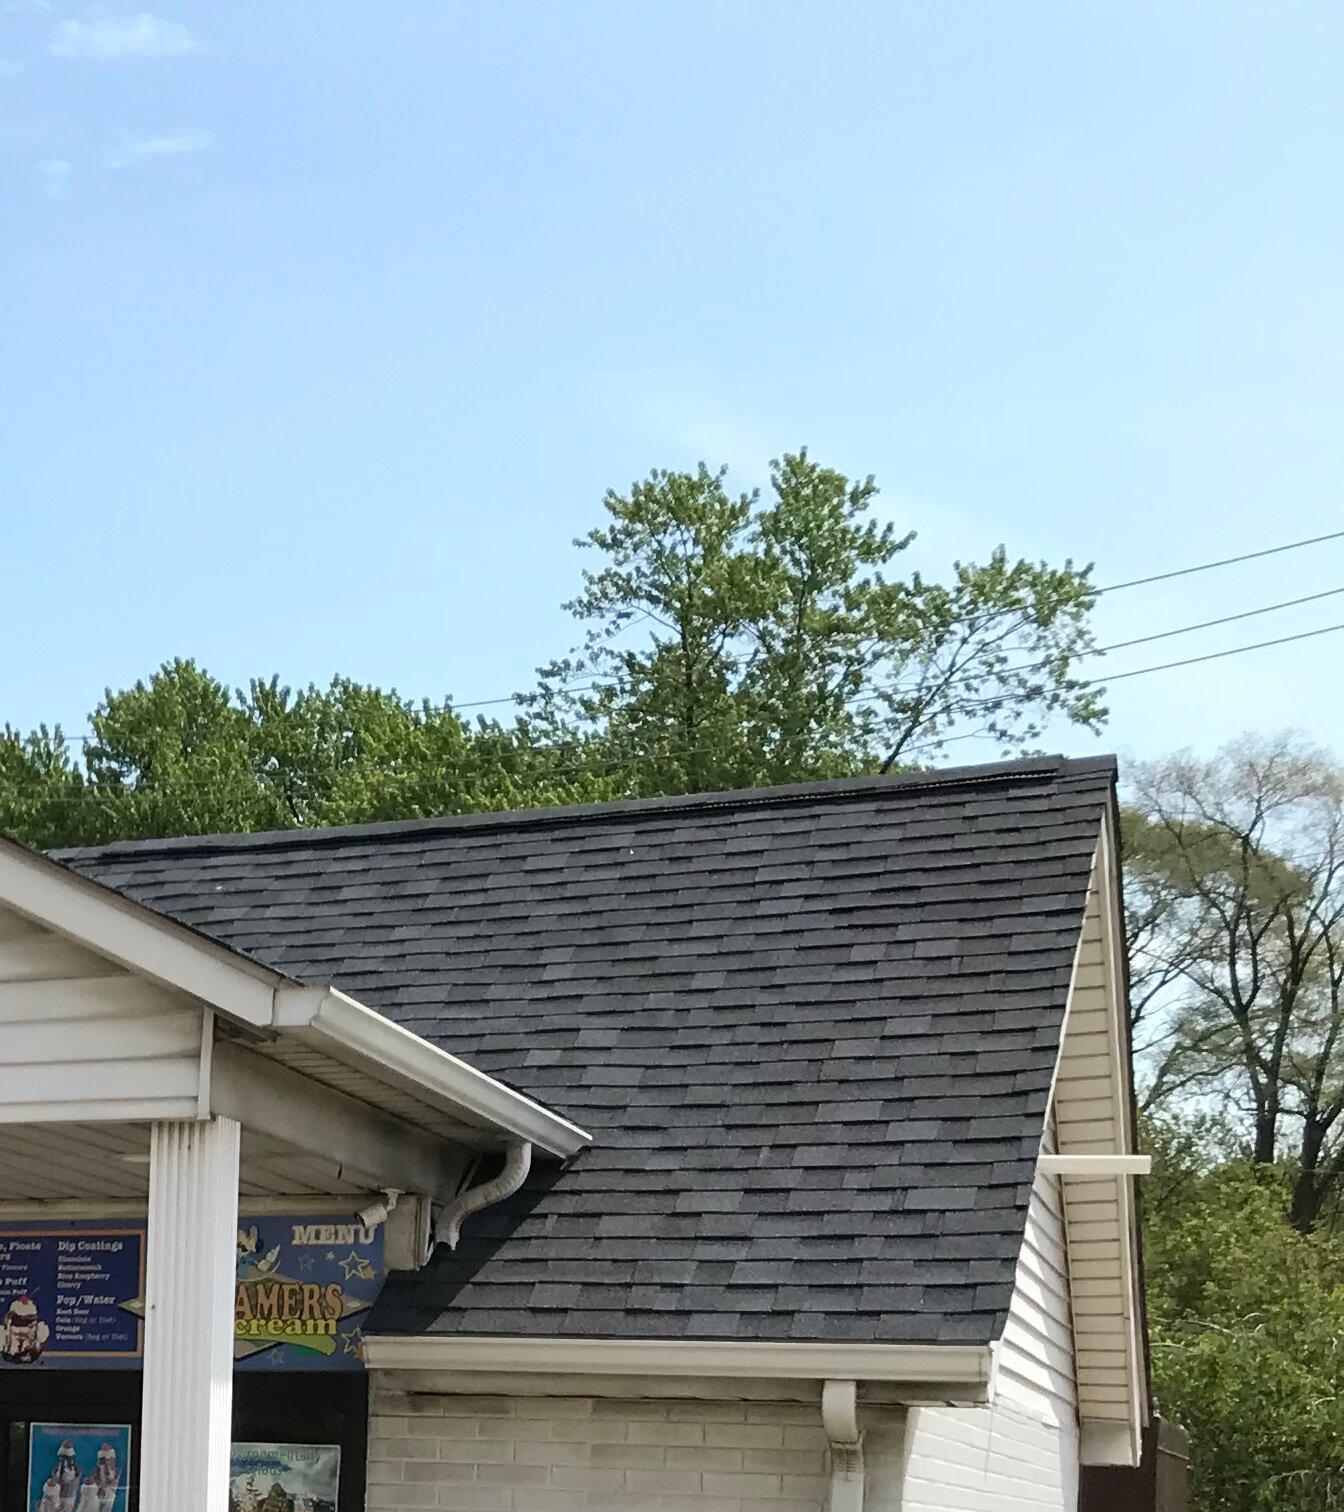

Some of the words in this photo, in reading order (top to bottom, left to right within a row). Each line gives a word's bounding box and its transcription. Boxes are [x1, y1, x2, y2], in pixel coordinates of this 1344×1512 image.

[292, 1224, 378, 1246] MENU
[9, 1242, 41, 1251] Floats
[58, 1241, 76, 1252] Dip
[78, 1241, 123, 1252] Coatings
[56, 1295, 116, 1307] Pop/Water
[236, 1283, 344, 1321] AMERS
[236, 1316, 338, 1336] cream
